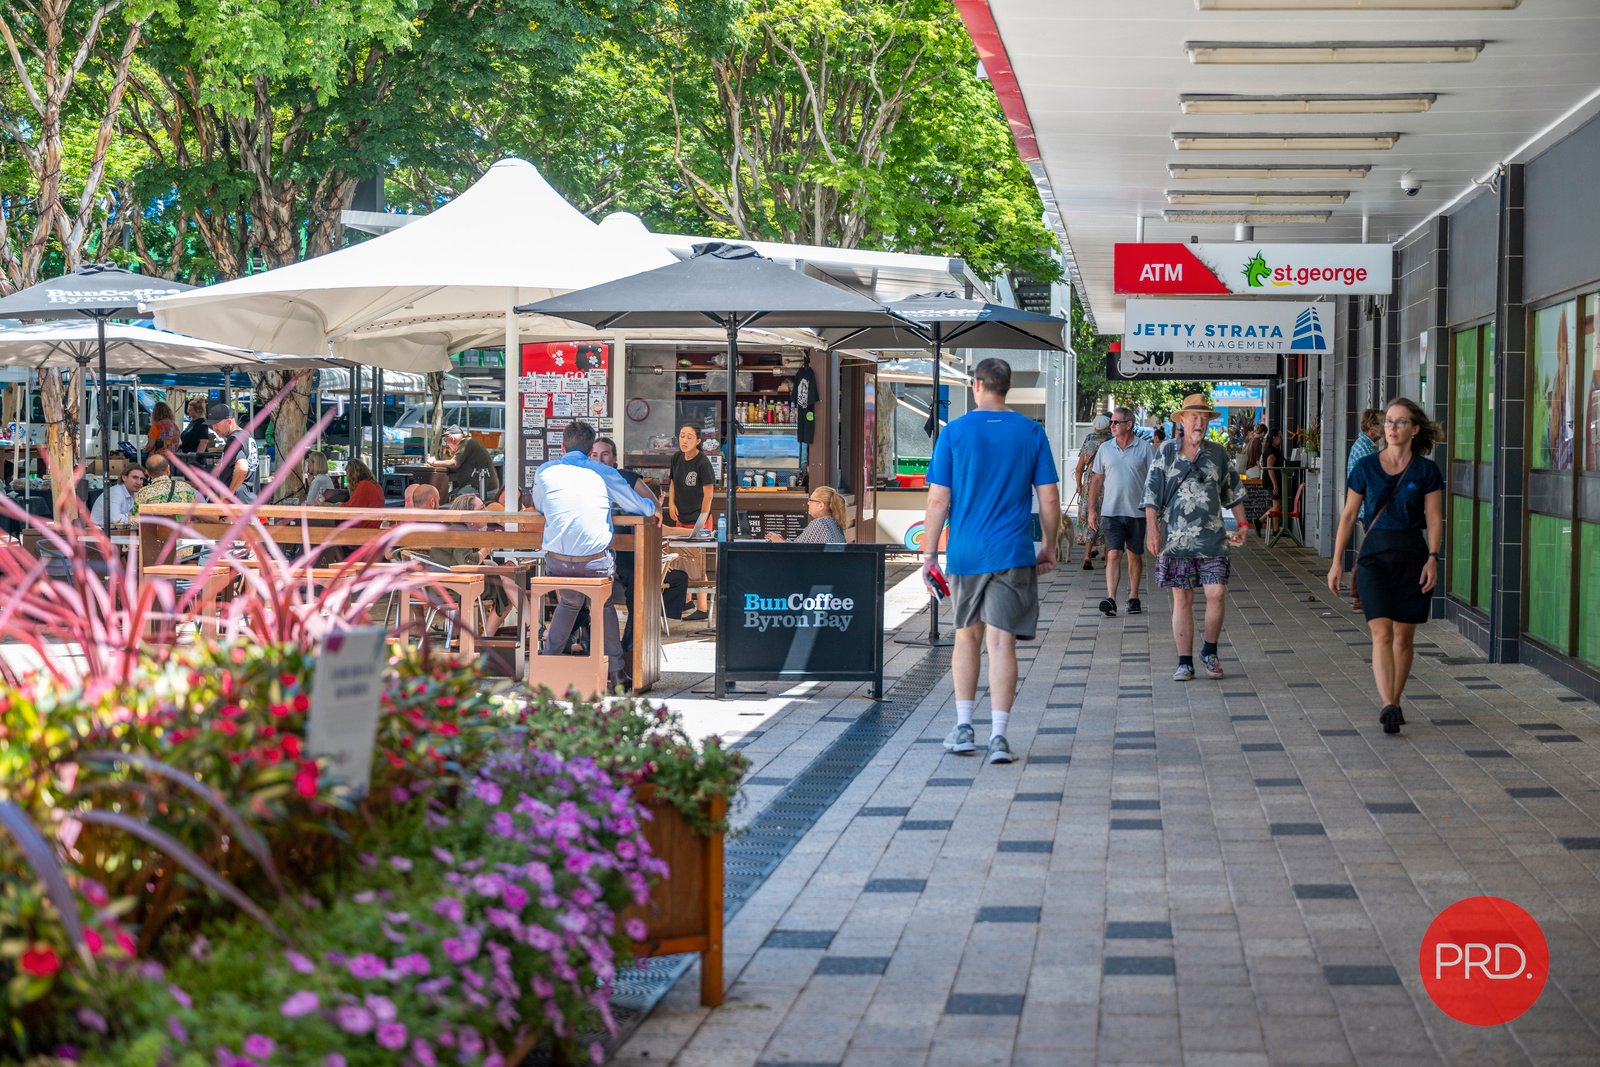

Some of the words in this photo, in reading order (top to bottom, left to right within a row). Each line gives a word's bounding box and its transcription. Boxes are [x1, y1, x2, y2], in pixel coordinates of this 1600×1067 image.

[1139, 263, 1183, 281] ATM
[1274, 264, 1367, 285] st.george
[45, 288, 181, 297] BunCoffee
[49, 295, 130, 304] Byron
[1133, 323, 1196, 337] JETTY
[1205, 324, 1283, 338] STRATA
[1186, 340, 1284, 350] MANAGEMENT
[1210, 388, 1229, 398] Park
[1230, 388, 1247, 398] Ave
[743, 592, 855, 611] BunCoffee
[743, 610, 810, 633] Byron
[813, 610, 854, 632] Bay
